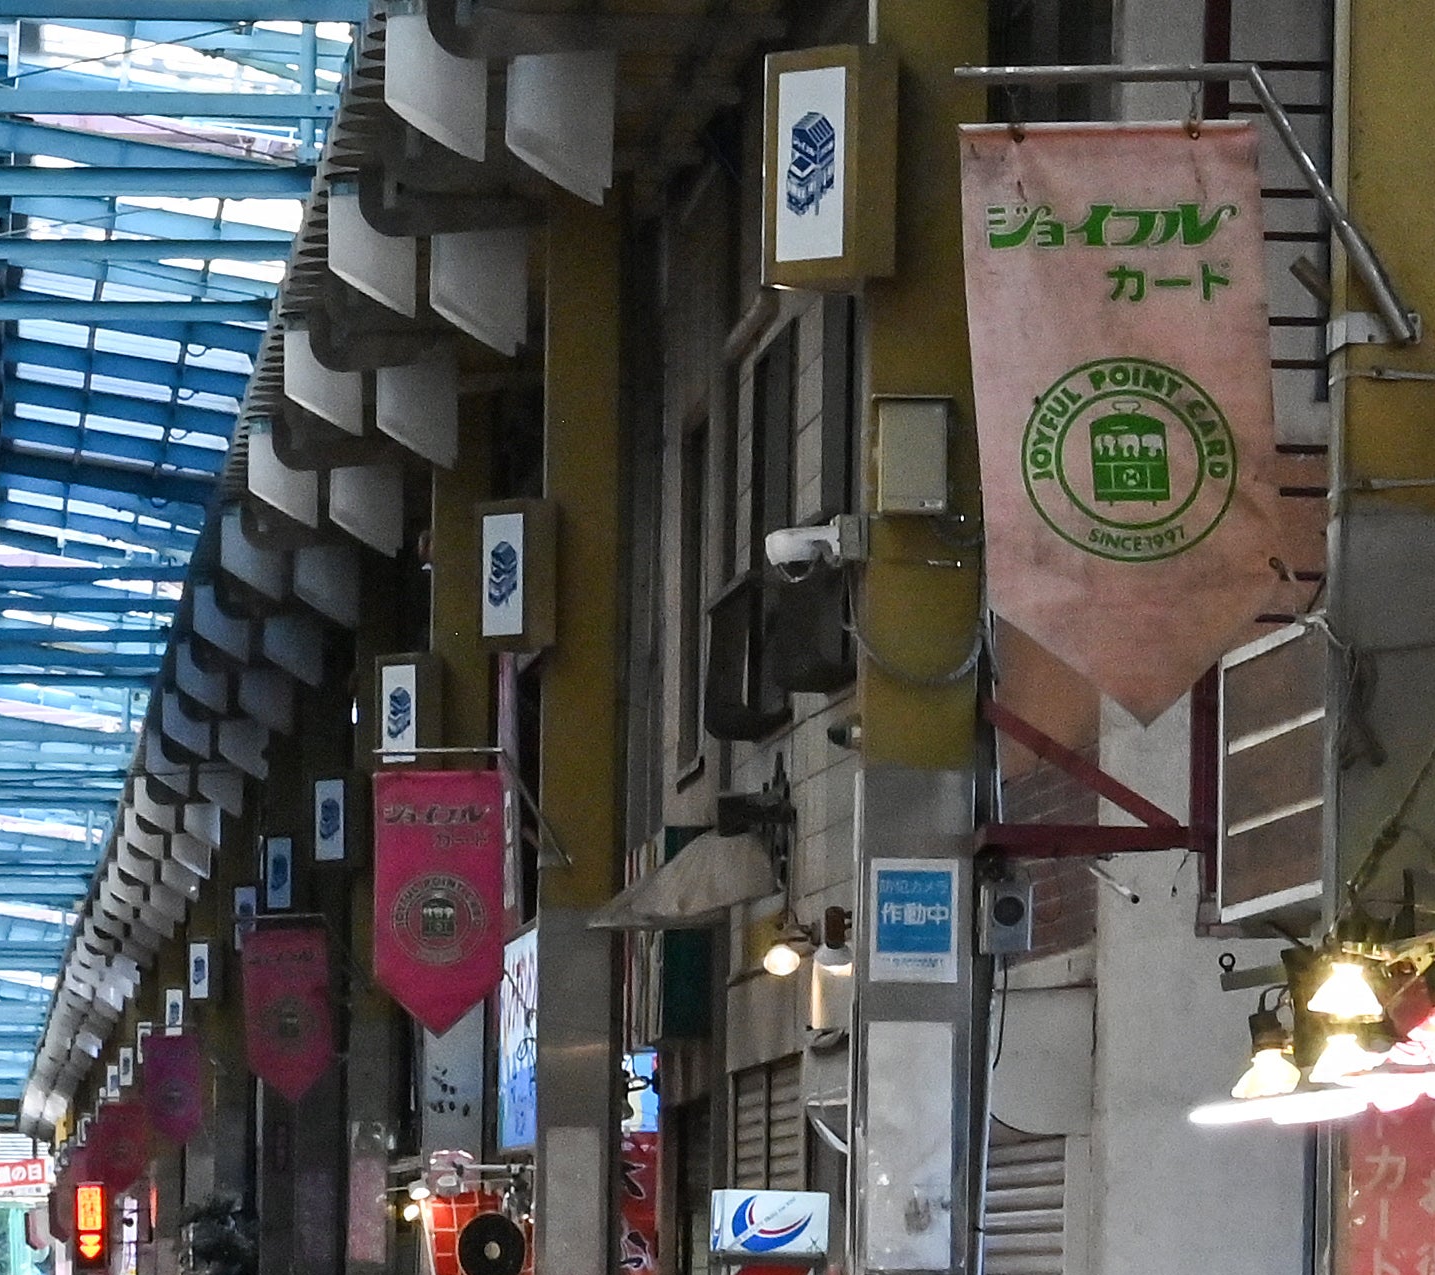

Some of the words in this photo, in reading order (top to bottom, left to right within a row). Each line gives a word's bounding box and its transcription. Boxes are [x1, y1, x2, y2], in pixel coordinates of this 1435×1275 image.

[987, 203, 1239, 249] ジョイフル
[1105, 261, 1231, 302] カード
[1029, 385, 1083, 482] JOYFUL
[1087, 364, 1183, 399] POINT
[1185, 398, 1231, 480] CARD
[881, 902, 950, 926] 作動中
